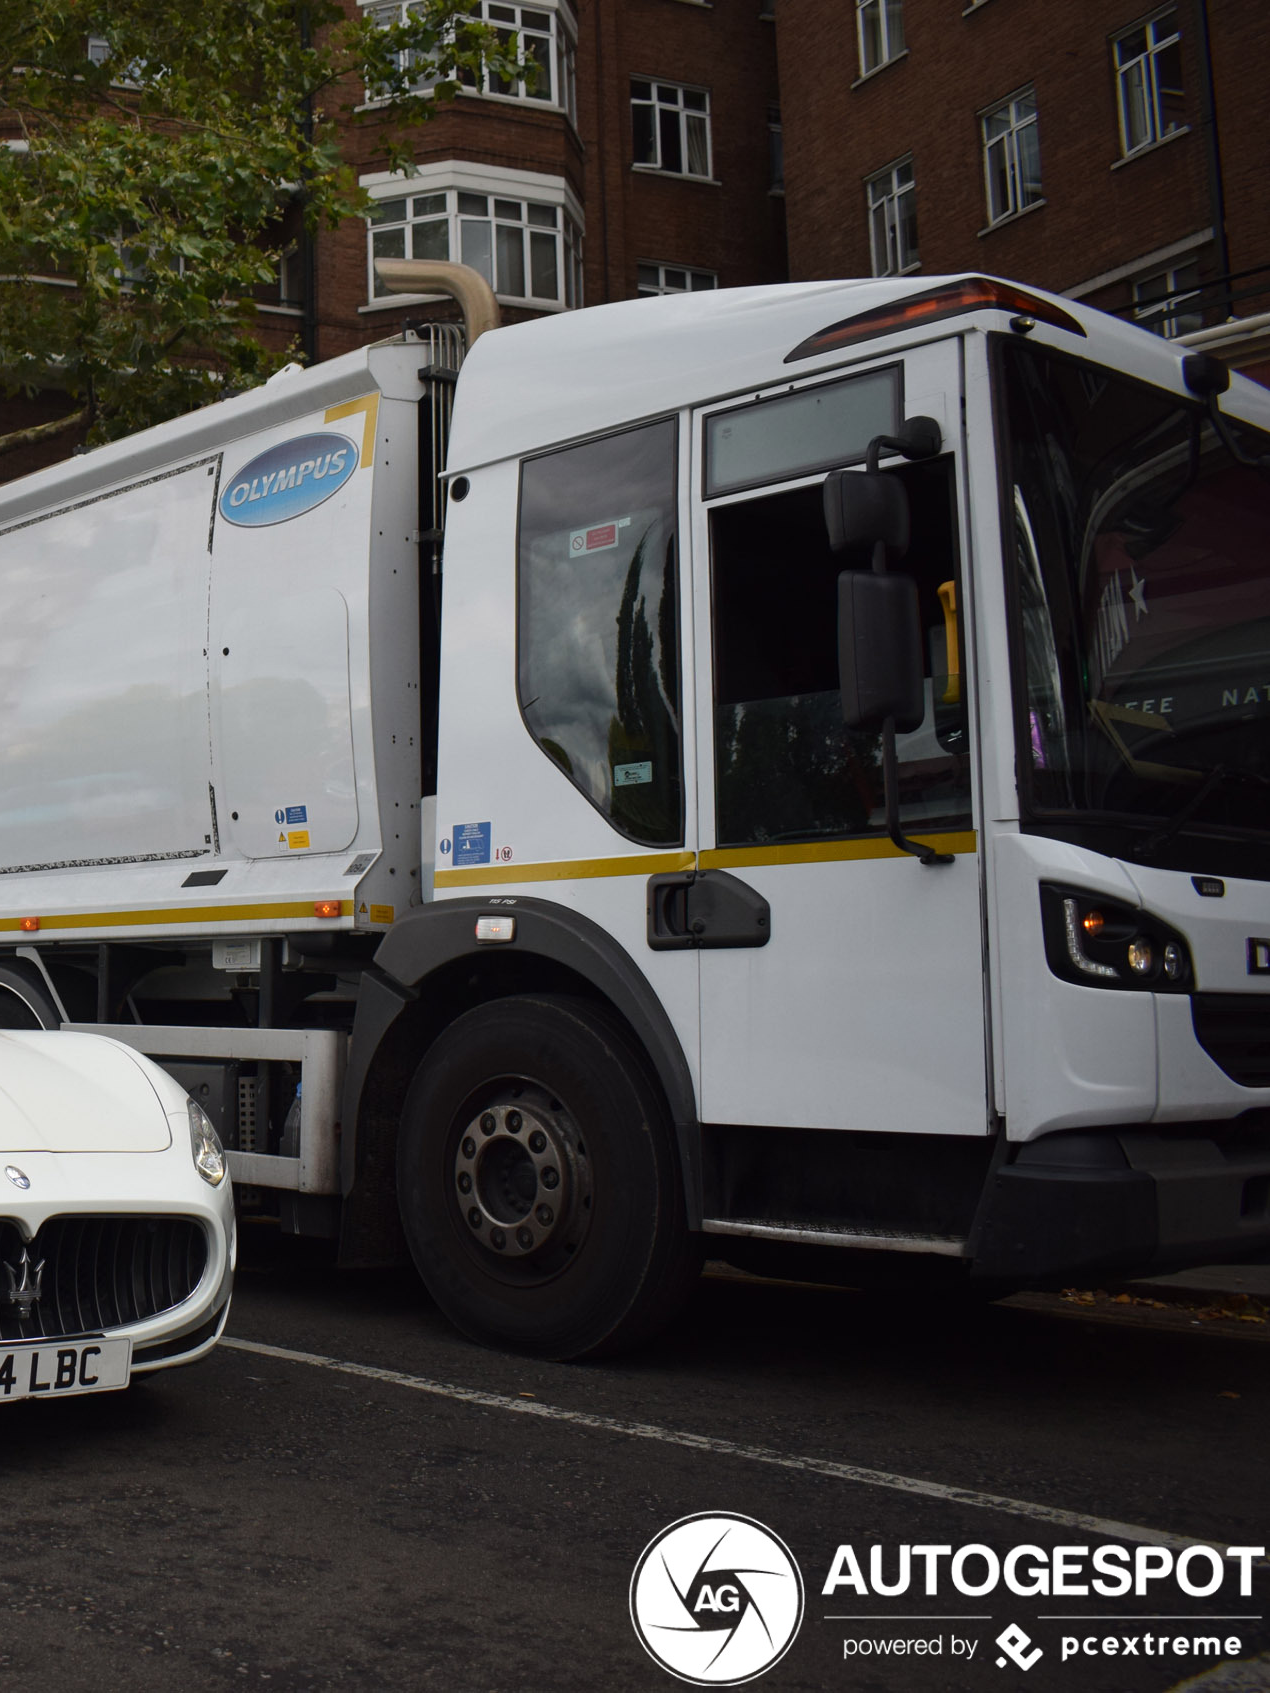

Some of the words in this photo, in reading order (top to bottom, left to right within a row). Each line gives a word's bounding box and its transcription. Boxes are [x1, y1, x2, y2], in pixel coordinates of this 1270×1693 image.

[229, 448, 347, 507] OLYMPUS
[1114, 697, 1173, 714] FEE
[29, 1346, 101, 1392] LBC
